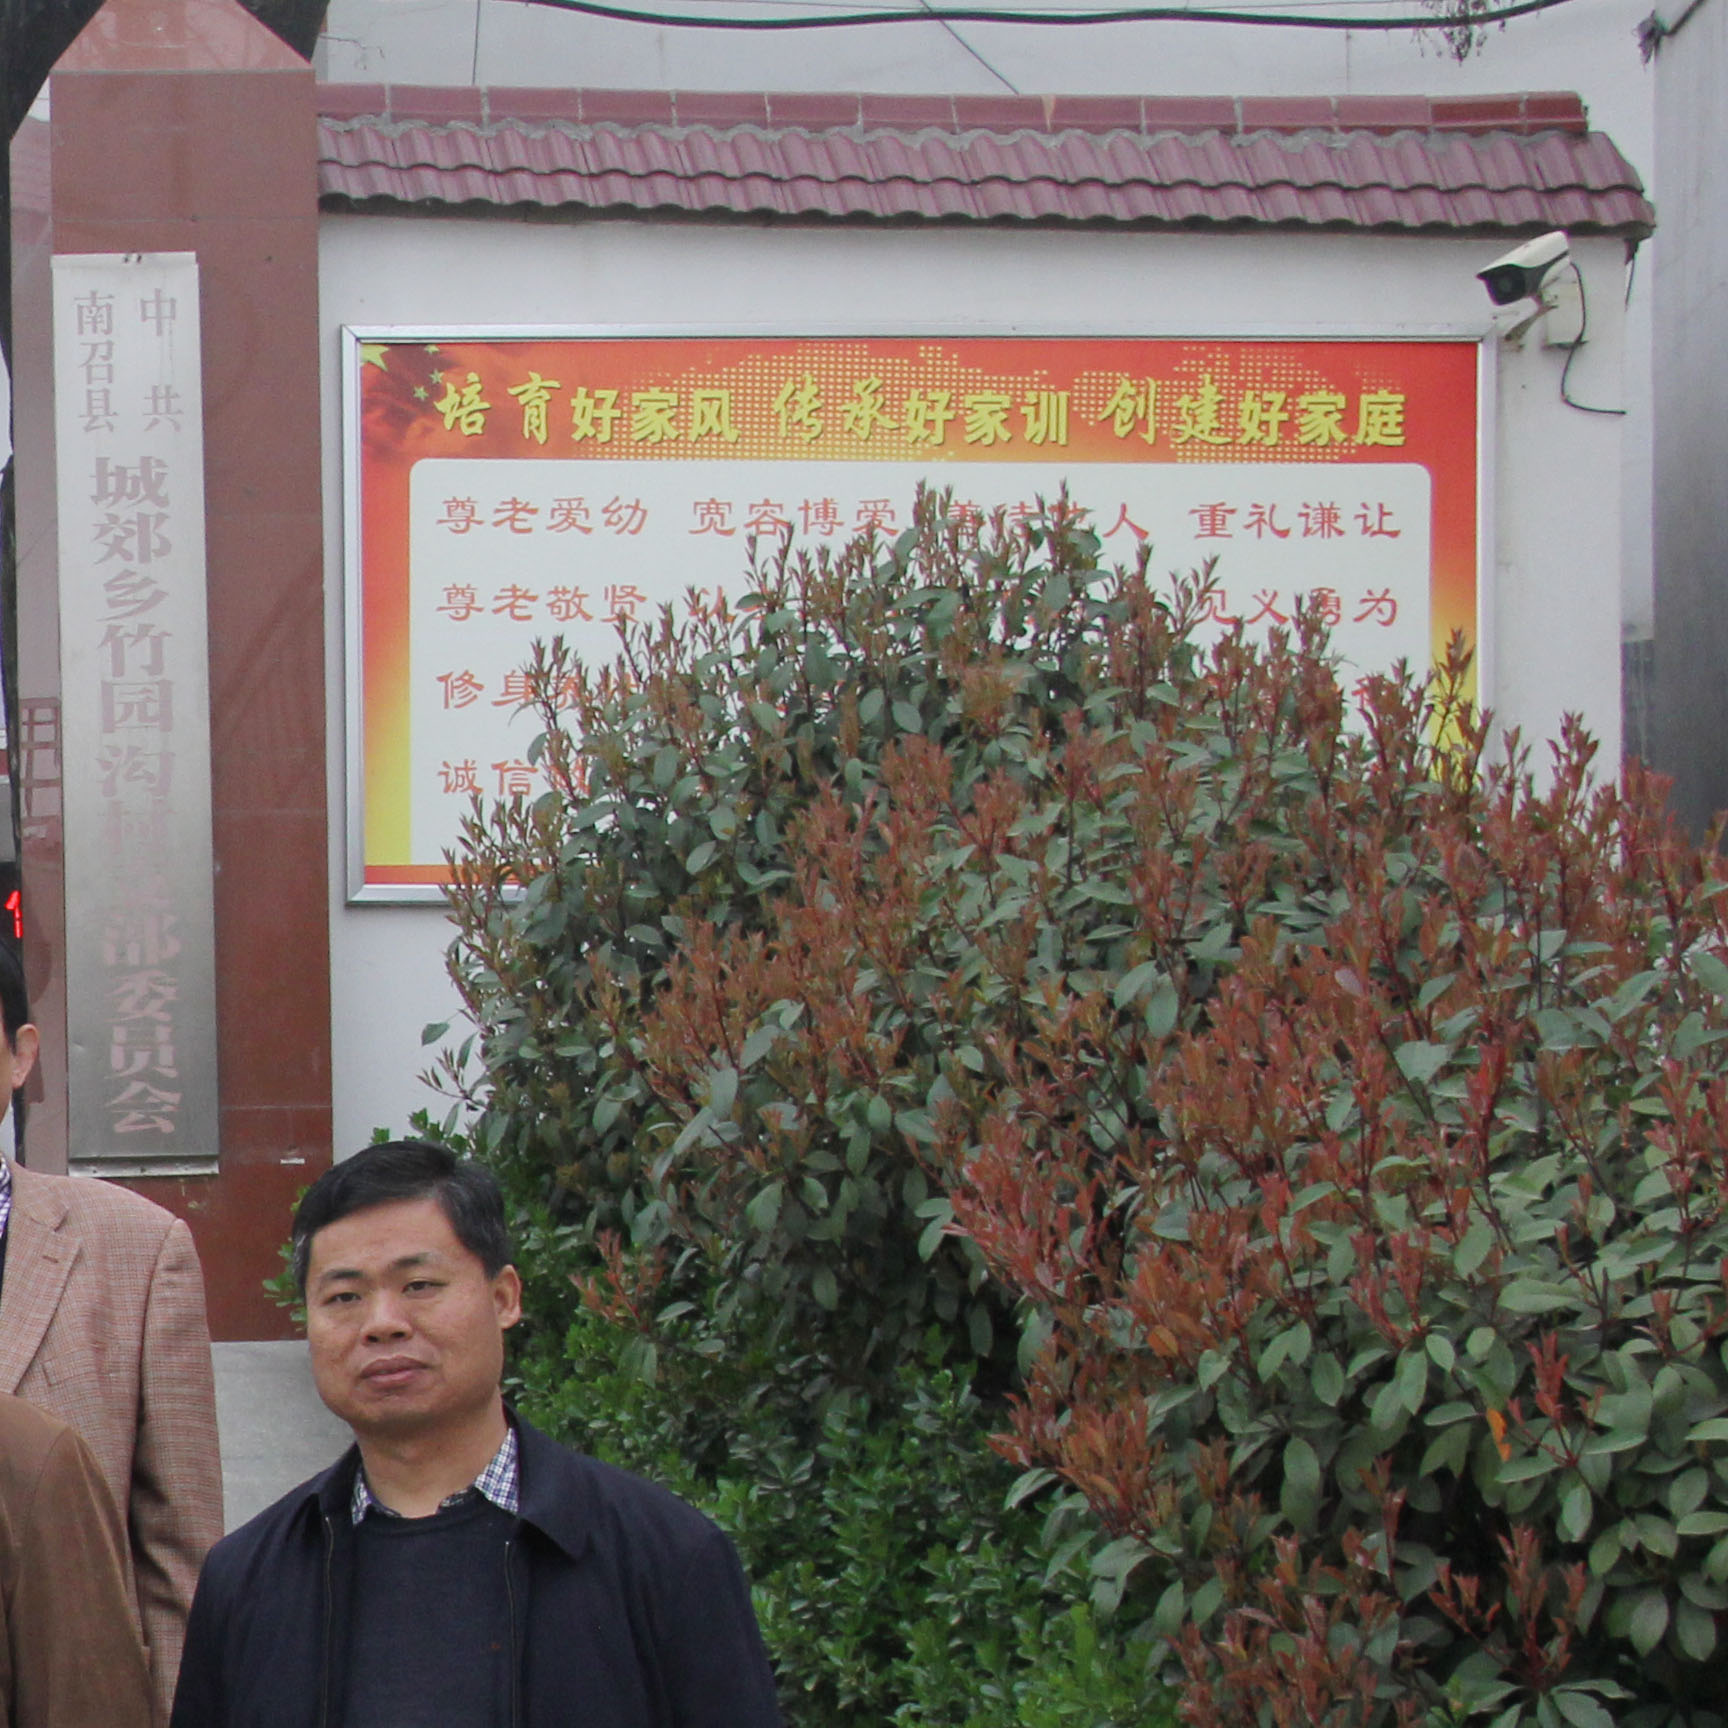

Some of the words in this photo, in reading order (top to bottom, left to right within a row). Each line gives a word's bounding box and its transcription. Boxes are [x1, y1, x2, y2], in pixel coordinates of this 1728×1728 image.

[74, 289, 119, 432] 南召县
[139, 288, 184, 433] 中共
[434, 372, 740, 445] 培育好家风
[773, 373, 1070, 446] 传承好家训
[1098, 374, 1407, 447] 创建好家庭
[436, 496, 648, 535] 尊老爱幼
[688, 497, 900, 537] 宽容博爱
[1188, 501, 1402, 539] 重礼谦让
[436, 583, 648, 623] 尊老敬贤
